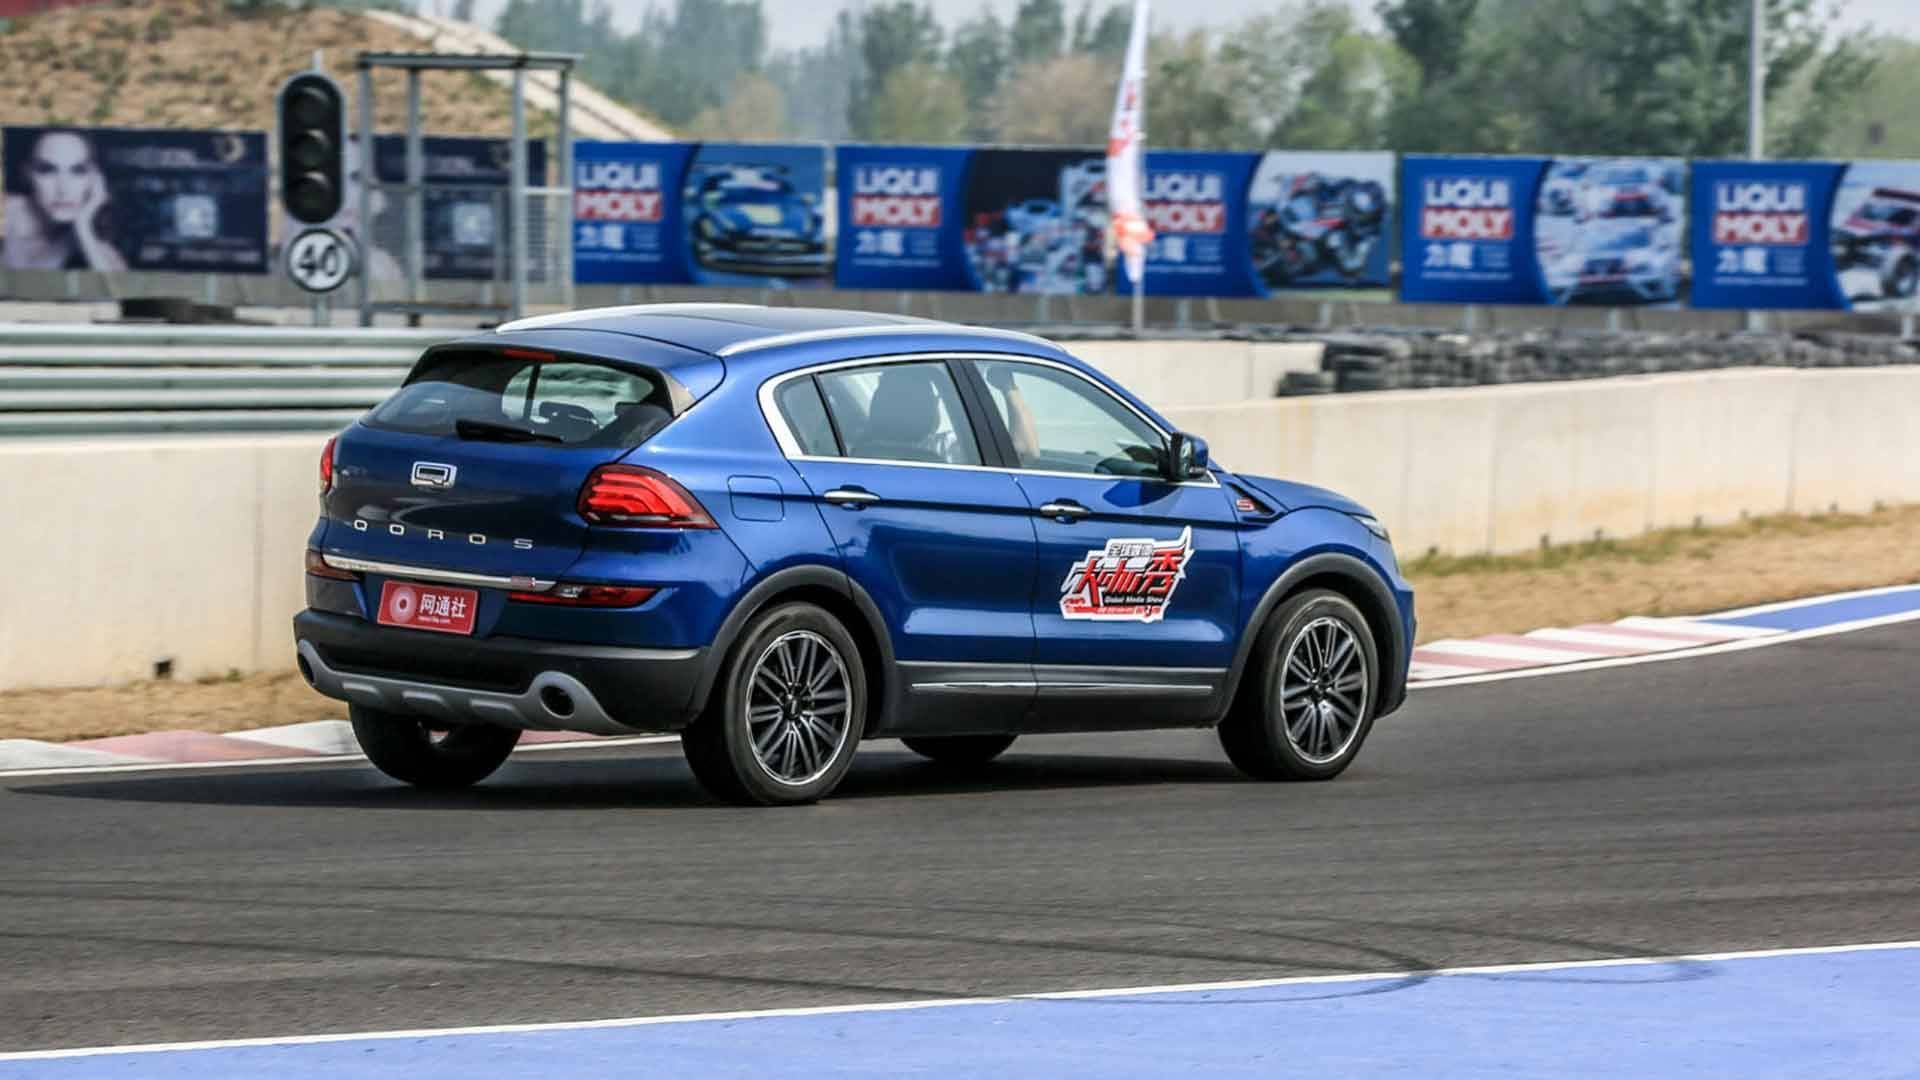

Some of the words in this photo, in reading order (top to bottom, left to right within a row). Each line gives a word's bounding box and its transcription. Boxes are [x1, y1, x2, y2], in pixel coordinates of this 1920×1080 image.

[577, 162, 659, 189] LIQUI
[856, 166, 938, 195] LIQUI
[577, 191, 660, 220] MOLY
[1425, 179, 1509, 208] LIQUI
[1717, 184, 1803, 212] LIQUI
[855, 196, 939, 225] MOLY
[1424, 210, 1510, 239] MOLY
[1716, 214, 1803, 243] MOLY
[298, 243, 338, 279] 40
[353, 518, 533, 550] QOROS
[420, 593, 467, 618] 网通社
